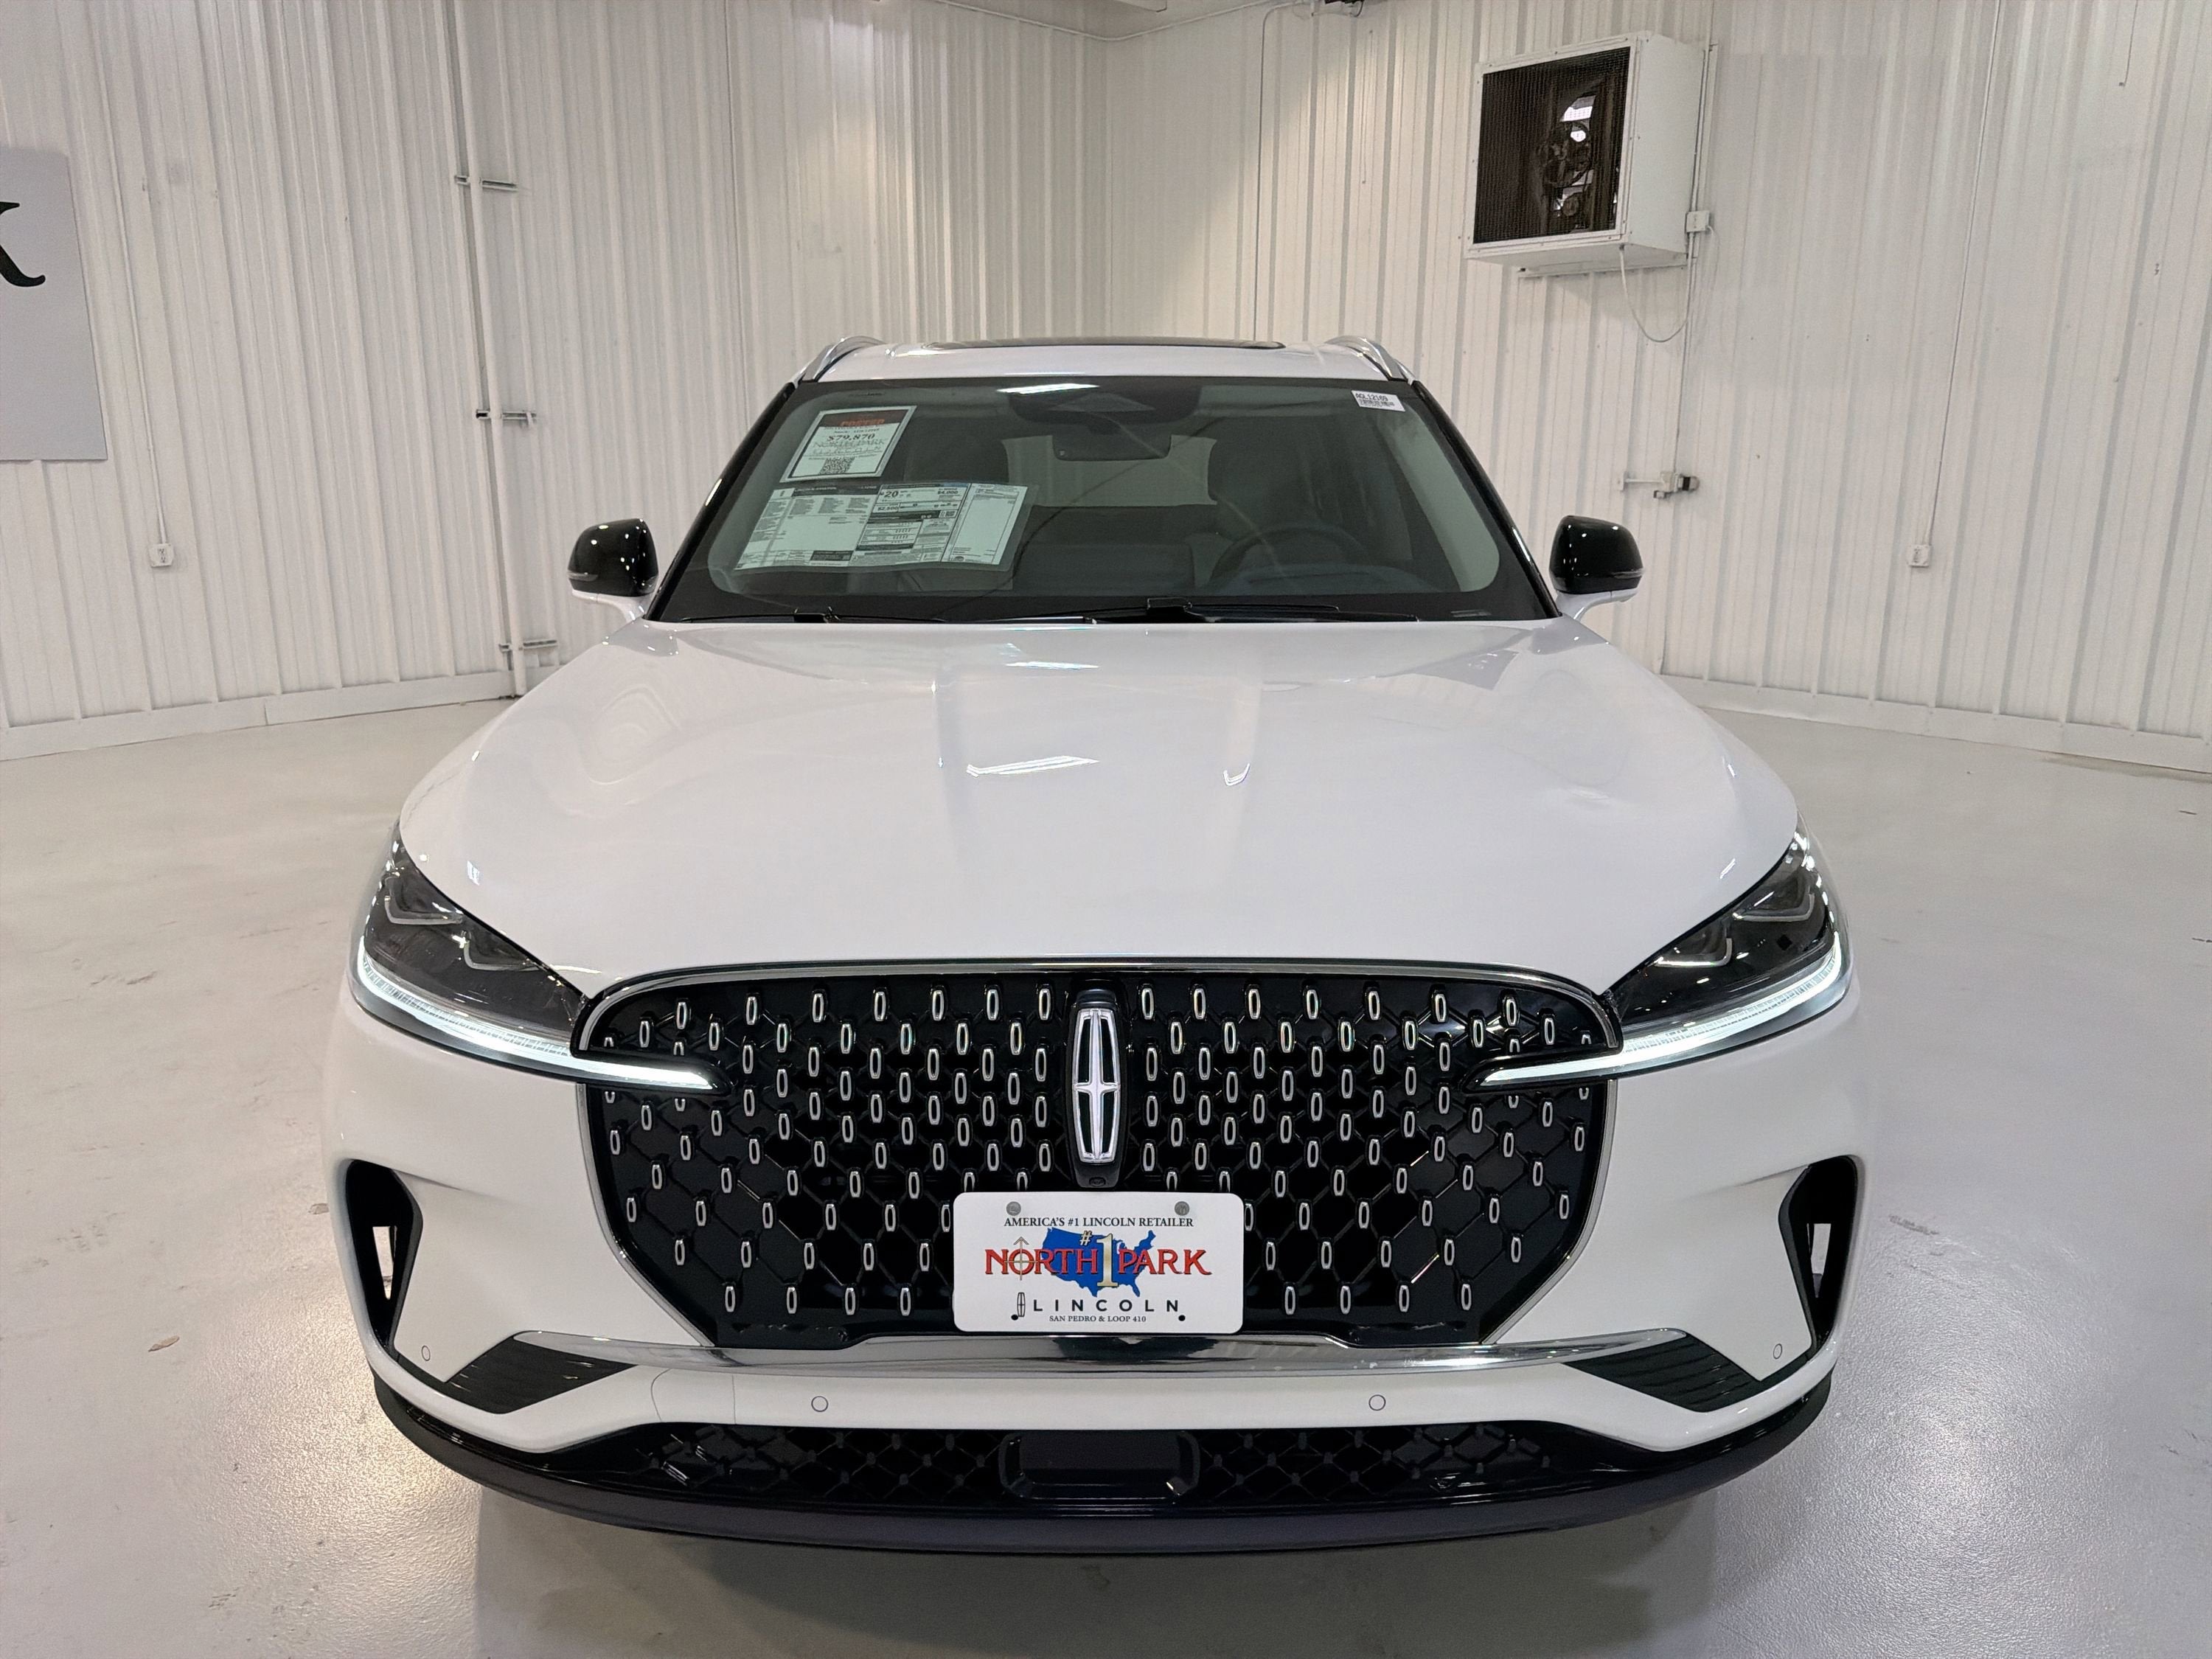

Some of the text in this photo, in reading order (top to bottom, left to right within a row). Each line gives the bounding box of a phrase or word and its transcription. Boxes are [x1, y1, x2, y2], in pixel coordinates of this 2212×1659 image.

[827, 434, 876, 442] $79,870
[1004, 1217, 1194, 1228] AMERICA'S #1 LINCOLN RETAILER
[984, 1248, 1213, 1276] NORTH PARK
[1033, 1299, 1178, 1312] LINCOLN
